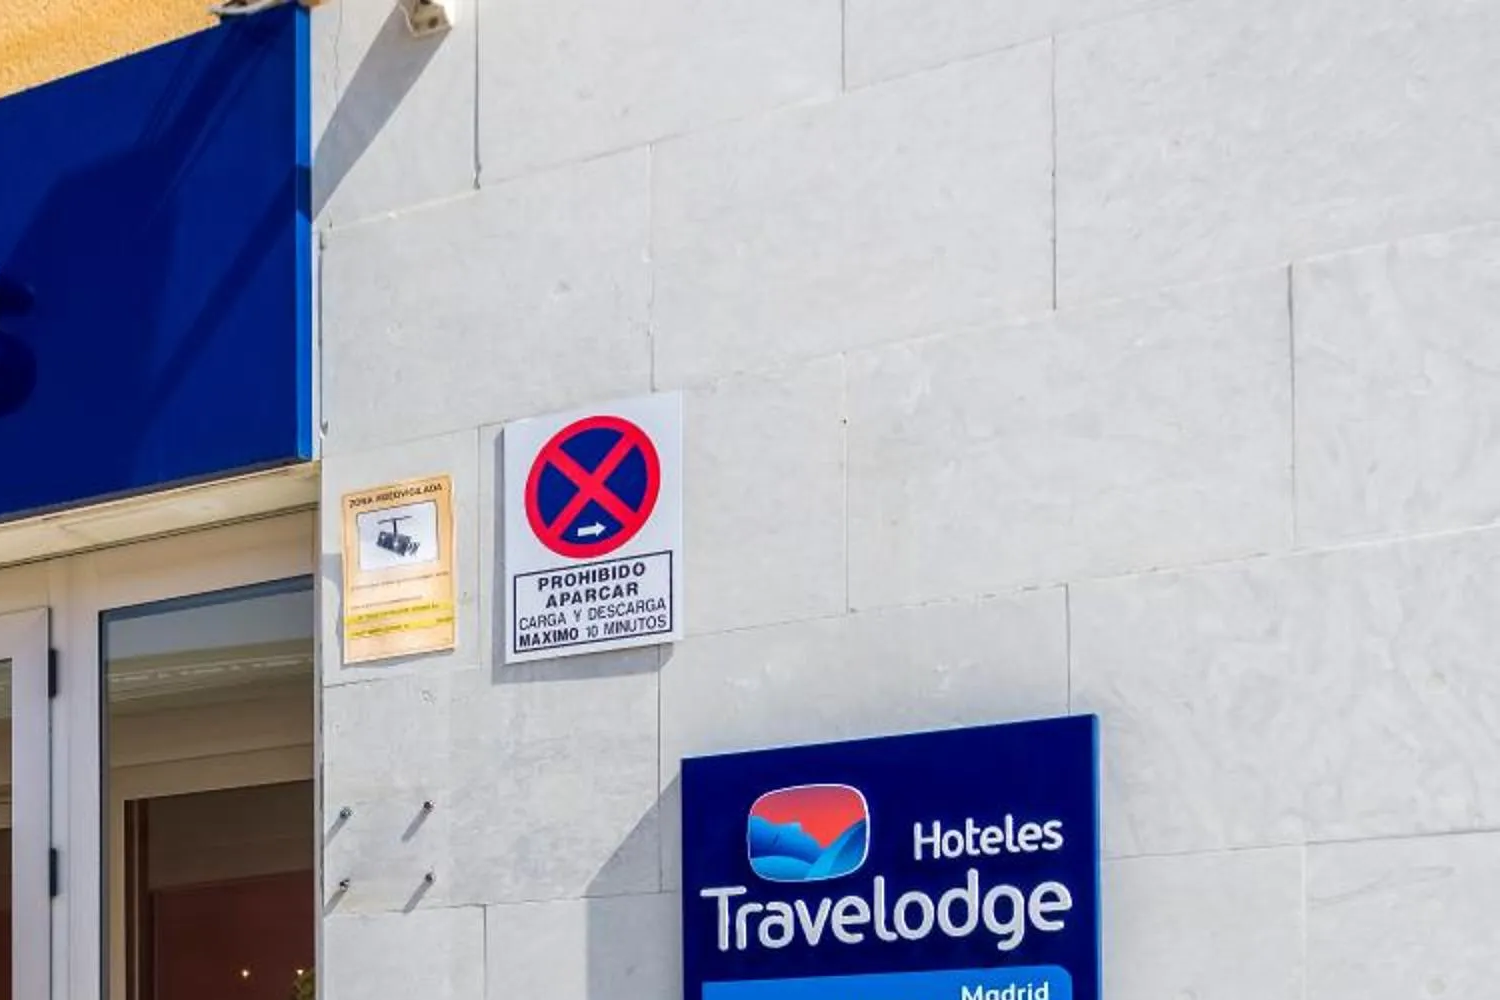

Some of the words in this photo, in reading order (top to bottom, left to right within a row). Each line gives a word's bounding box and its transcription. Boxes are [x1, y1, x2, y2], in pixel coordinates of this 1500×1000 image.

[538, 562, 646, 592] PROHIBIDO
[545, 582, 639, 608] APARCAR
[519, 611, 567, 631] CARGA
[573, 609, 582, 622] Y
[588, 597, 667, 621] DESCARGA
[519, 627, 579, 648] MAXIMO
[585, 625, 599, 638] 10
[603, 614, 667, 635] MINUTOS
[913, 813, 1064, 861] Hoteles
[700, 868, 1073, 951] Travelodge
